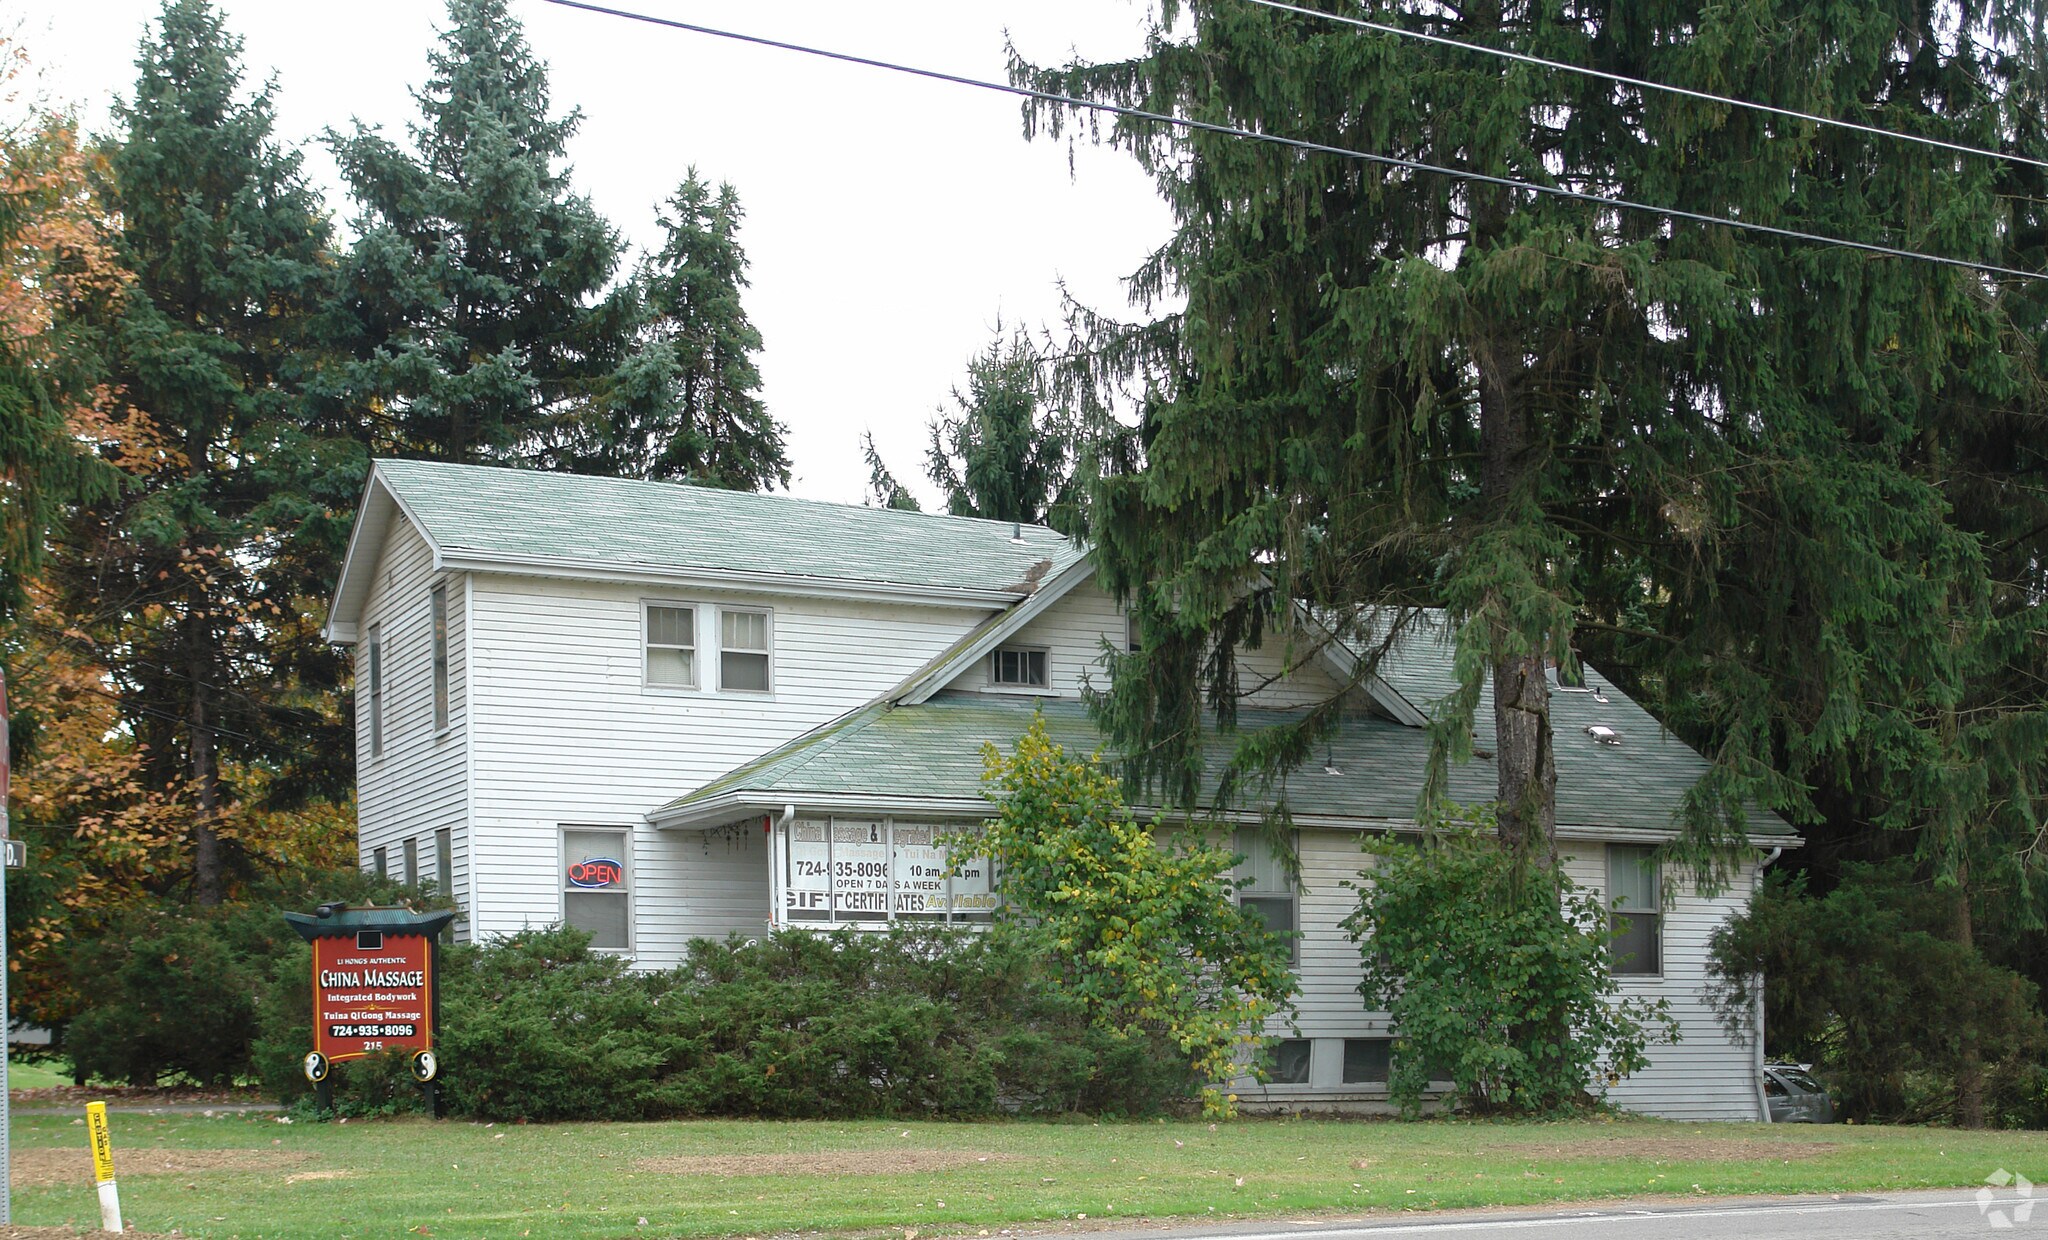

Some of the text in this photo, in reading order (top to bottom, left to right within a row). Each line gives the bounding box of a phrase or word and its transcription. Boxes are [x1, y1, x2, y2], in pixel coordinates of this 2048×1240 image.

[794, 822, 821, 841] China
[871, 824, 878, 842] &
[881, 824, 930, 848] Iegrated
[568, 863, 622, 884] OPEN
[909, 865, 922, 876] 10
[925, 868, 940, 877] am
[964, 869, 980, 880] pm
[836, 879, 942, 891] OPEN 7 DAS A WEEK
[845, 891, 925, 912] CERTIFIATES
[369, 957, 406, 965] AUTHENTIC
[320, 968, 424, 987] CHINA MASSAGE
[327, 992, 417, 1003] Integrated Bodywork
[324, 1011, 349, 1020] Tuina
[385, 1011, 421, 1021] Massage
[364, 1041, 383, 1051] 215
